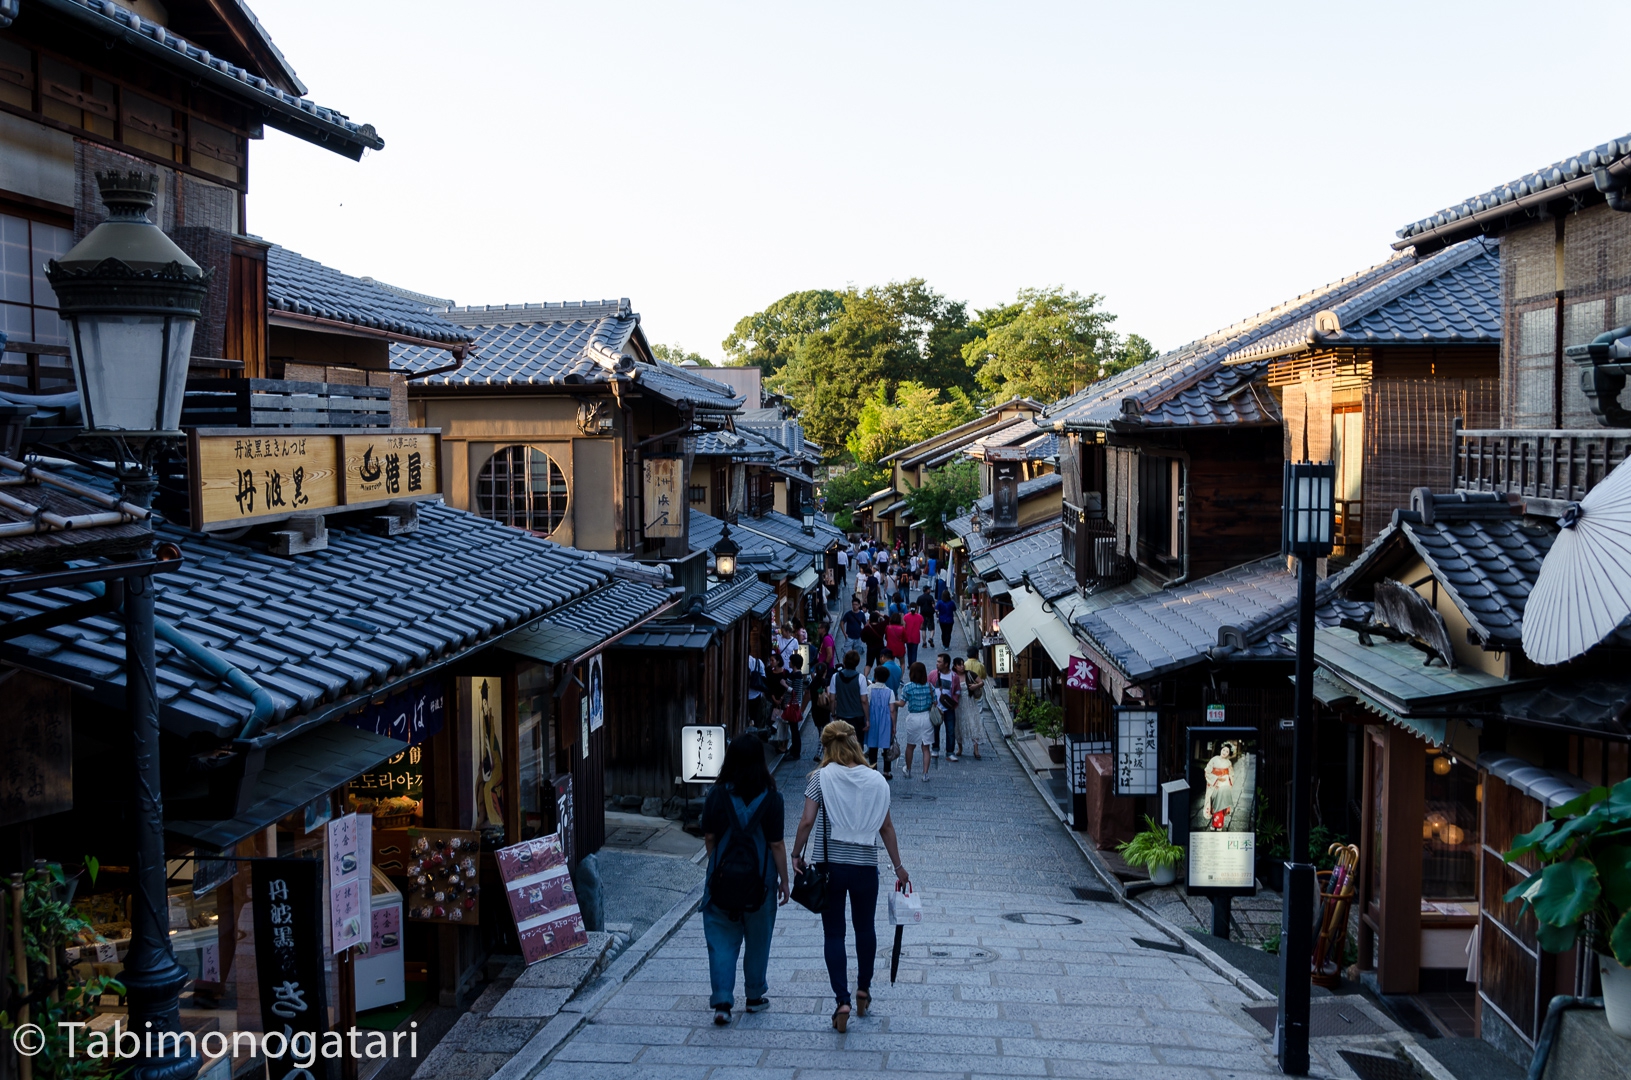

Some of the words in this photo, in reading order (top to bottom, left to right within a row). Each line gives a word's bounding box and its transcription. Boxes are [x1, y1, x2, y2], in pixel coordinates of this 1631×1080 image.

[234, 438, 307, 459] 丹波黒豆きんつば
[385, 451, 422, 495] 港屋
[234, 465, 309, 515] 丹波黒
[1073, 660, 1094, 680] 氷
[1208, 711, 1224, 719] 119
[1145, 719, 1156, 750] そば処
[1119, 753, 1134, 788] ふたば
[333, 823, 341, 877] どら焼き
[341, 822, 350, 847] 小倉
[334, 890, 343, 942] どら焼き
[372, 911, 381, 950] どら焼き
[382, 910, 392, 929] 小倉
